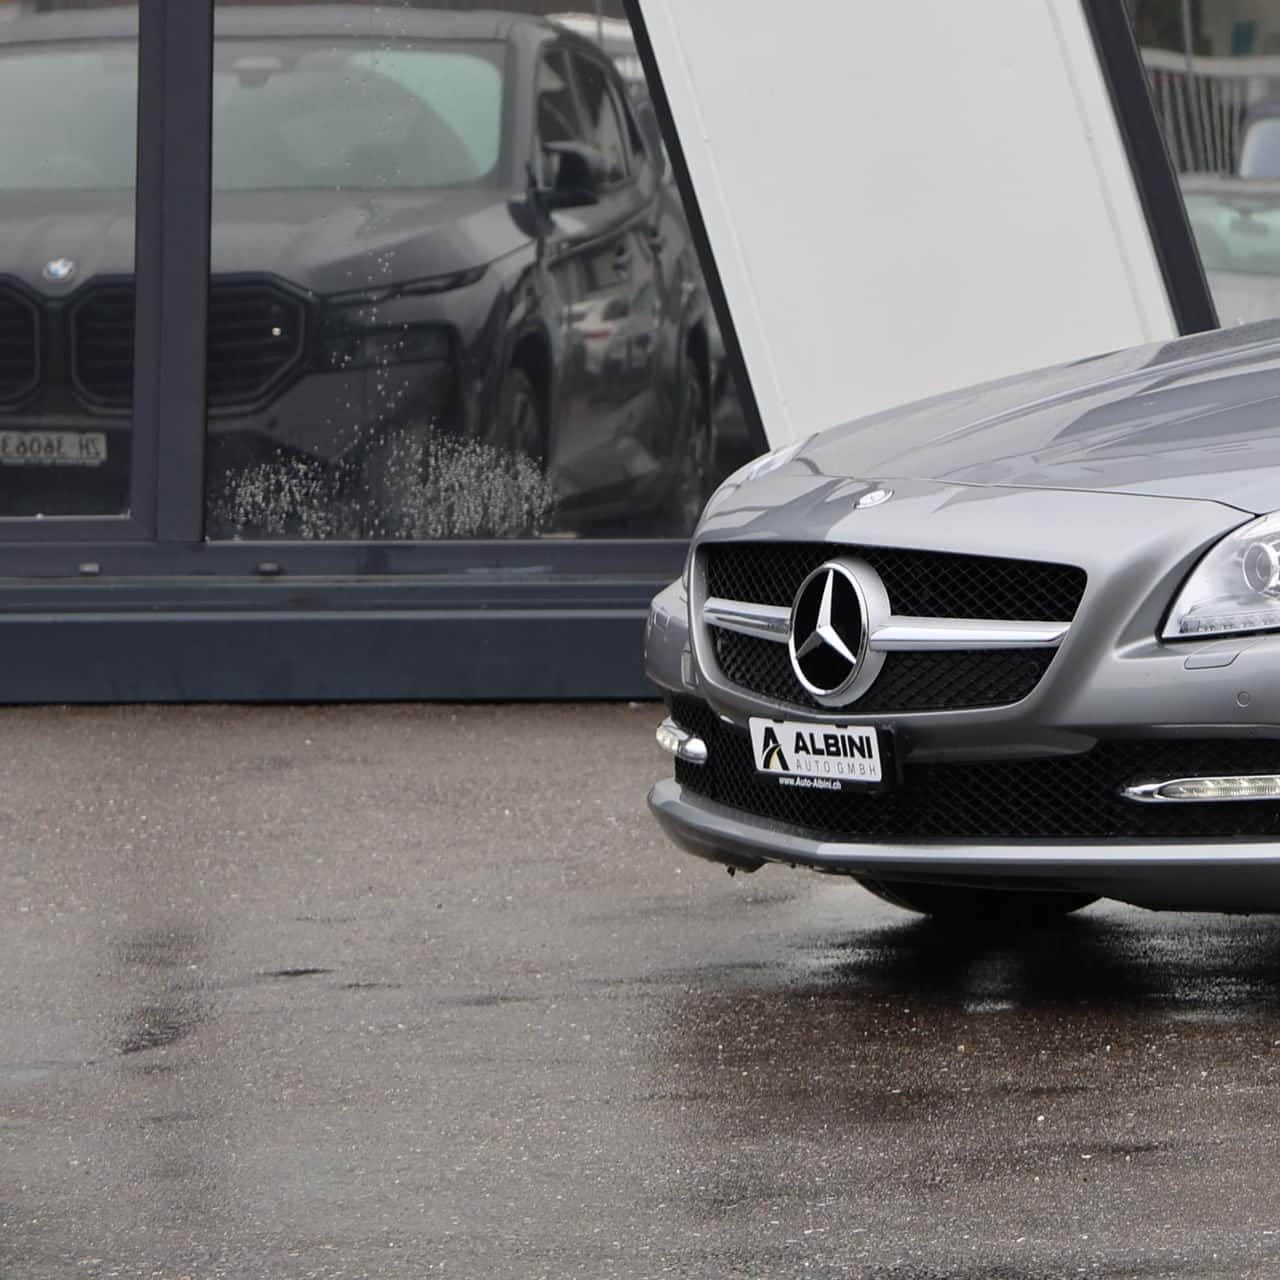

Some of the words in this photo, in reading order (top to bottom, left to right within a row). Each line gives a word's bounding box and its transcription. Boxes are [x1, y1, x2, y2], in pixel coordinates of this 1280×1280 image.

[794, 731, 873, 760] ALBINI
[796, 758, 830, 775] AUTO
[837, 761, 877, 777] GMBH
